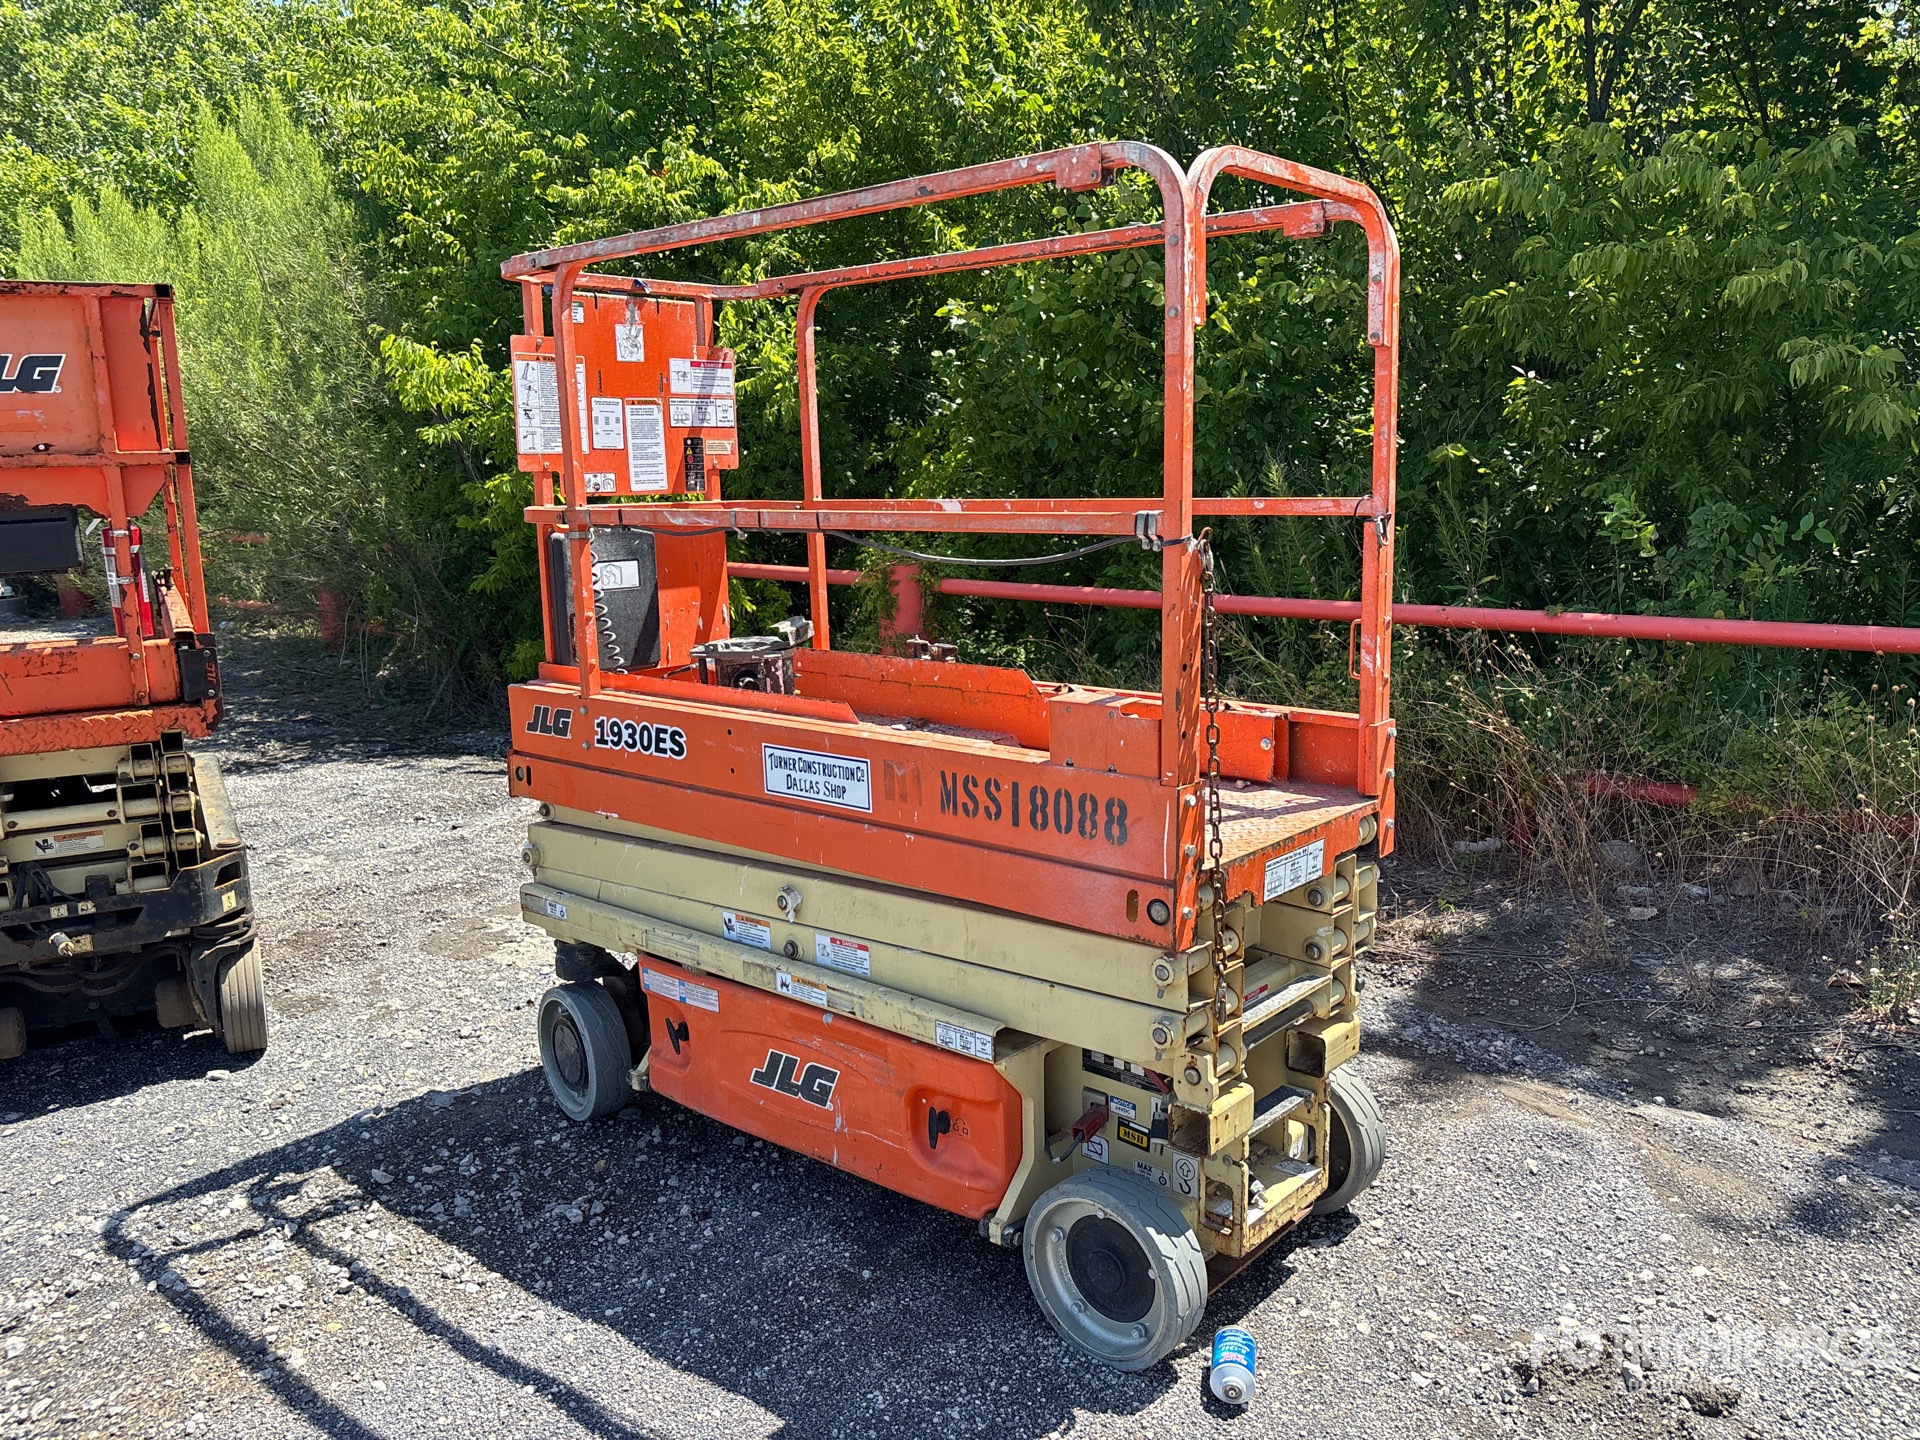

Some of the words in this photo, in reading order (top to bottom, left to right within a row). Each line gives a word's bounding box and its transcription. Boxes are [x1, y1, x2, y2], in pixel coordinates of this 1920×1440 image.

[525, 704, 573, 739] JLG
[594, 716, 687, 760] 1930ES
[768, 752, 797, 774] TURNER
[797, 757, 856, 781] CONSTRUCTION
[786, 774, 820, 795] DALLAS
[823, 780, 847, 800] SHOP
[939, 770, 1128, 846] MSS18088
[841, 940, 858, 949] DANGER
[750, 1048, 840, 1109] JLG
[1113, 1098, 1133, 1109] NOTICE
[1115, 1105, 1131, 1115] 24VDC
[1122, 1128, 1144, 1145] MSH
[1137, 1161, 1153, 1173] MAX
